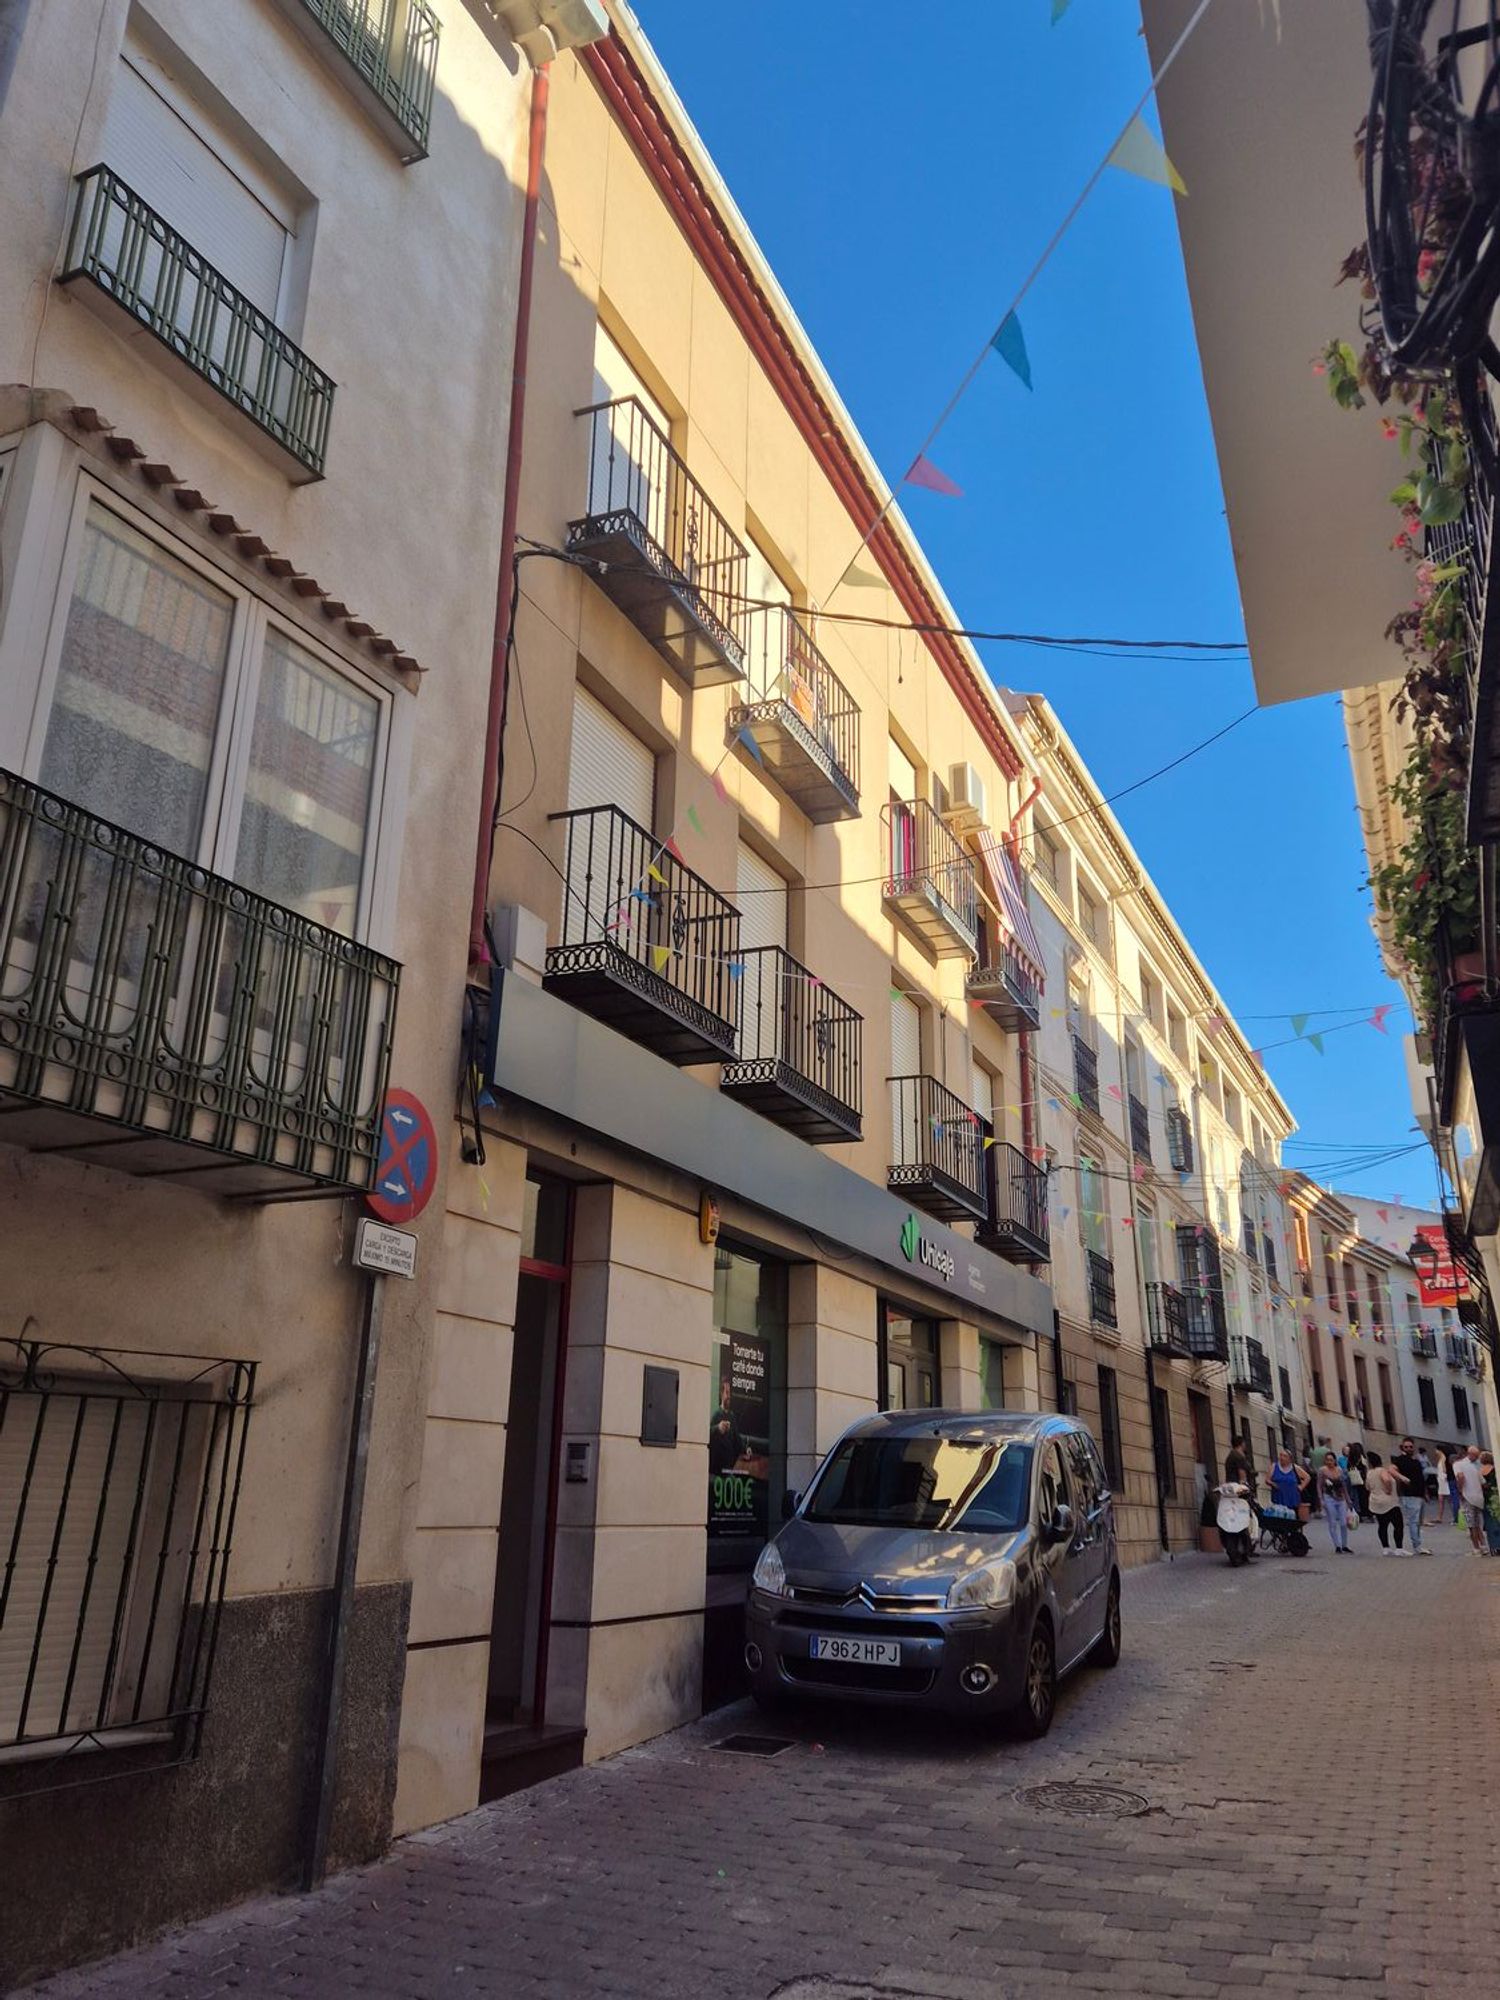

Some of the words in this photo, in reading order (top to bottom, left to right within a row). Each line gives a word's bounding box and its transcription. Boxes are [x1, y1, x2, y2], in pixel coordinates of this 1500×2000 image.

[365, 1239, 381, 1250] CARGA
[387, 1246, 412, 1259] DESCARGA
[920, 1237, 954, 1281] Unicaja
[733, 1342, 756, 1360] Tomarte
[758, 1349, 764, 1362] tu
[732, 1360, 745, 1373] café
[746, 1363, 764, 1377] donde
[732, 1375, 755, 1393] siempre
[714, 1476, 754, 1509] 900€
[820, 1640, 860, 1660] 7962
[865, 1644, 898, 1663] HPJ
